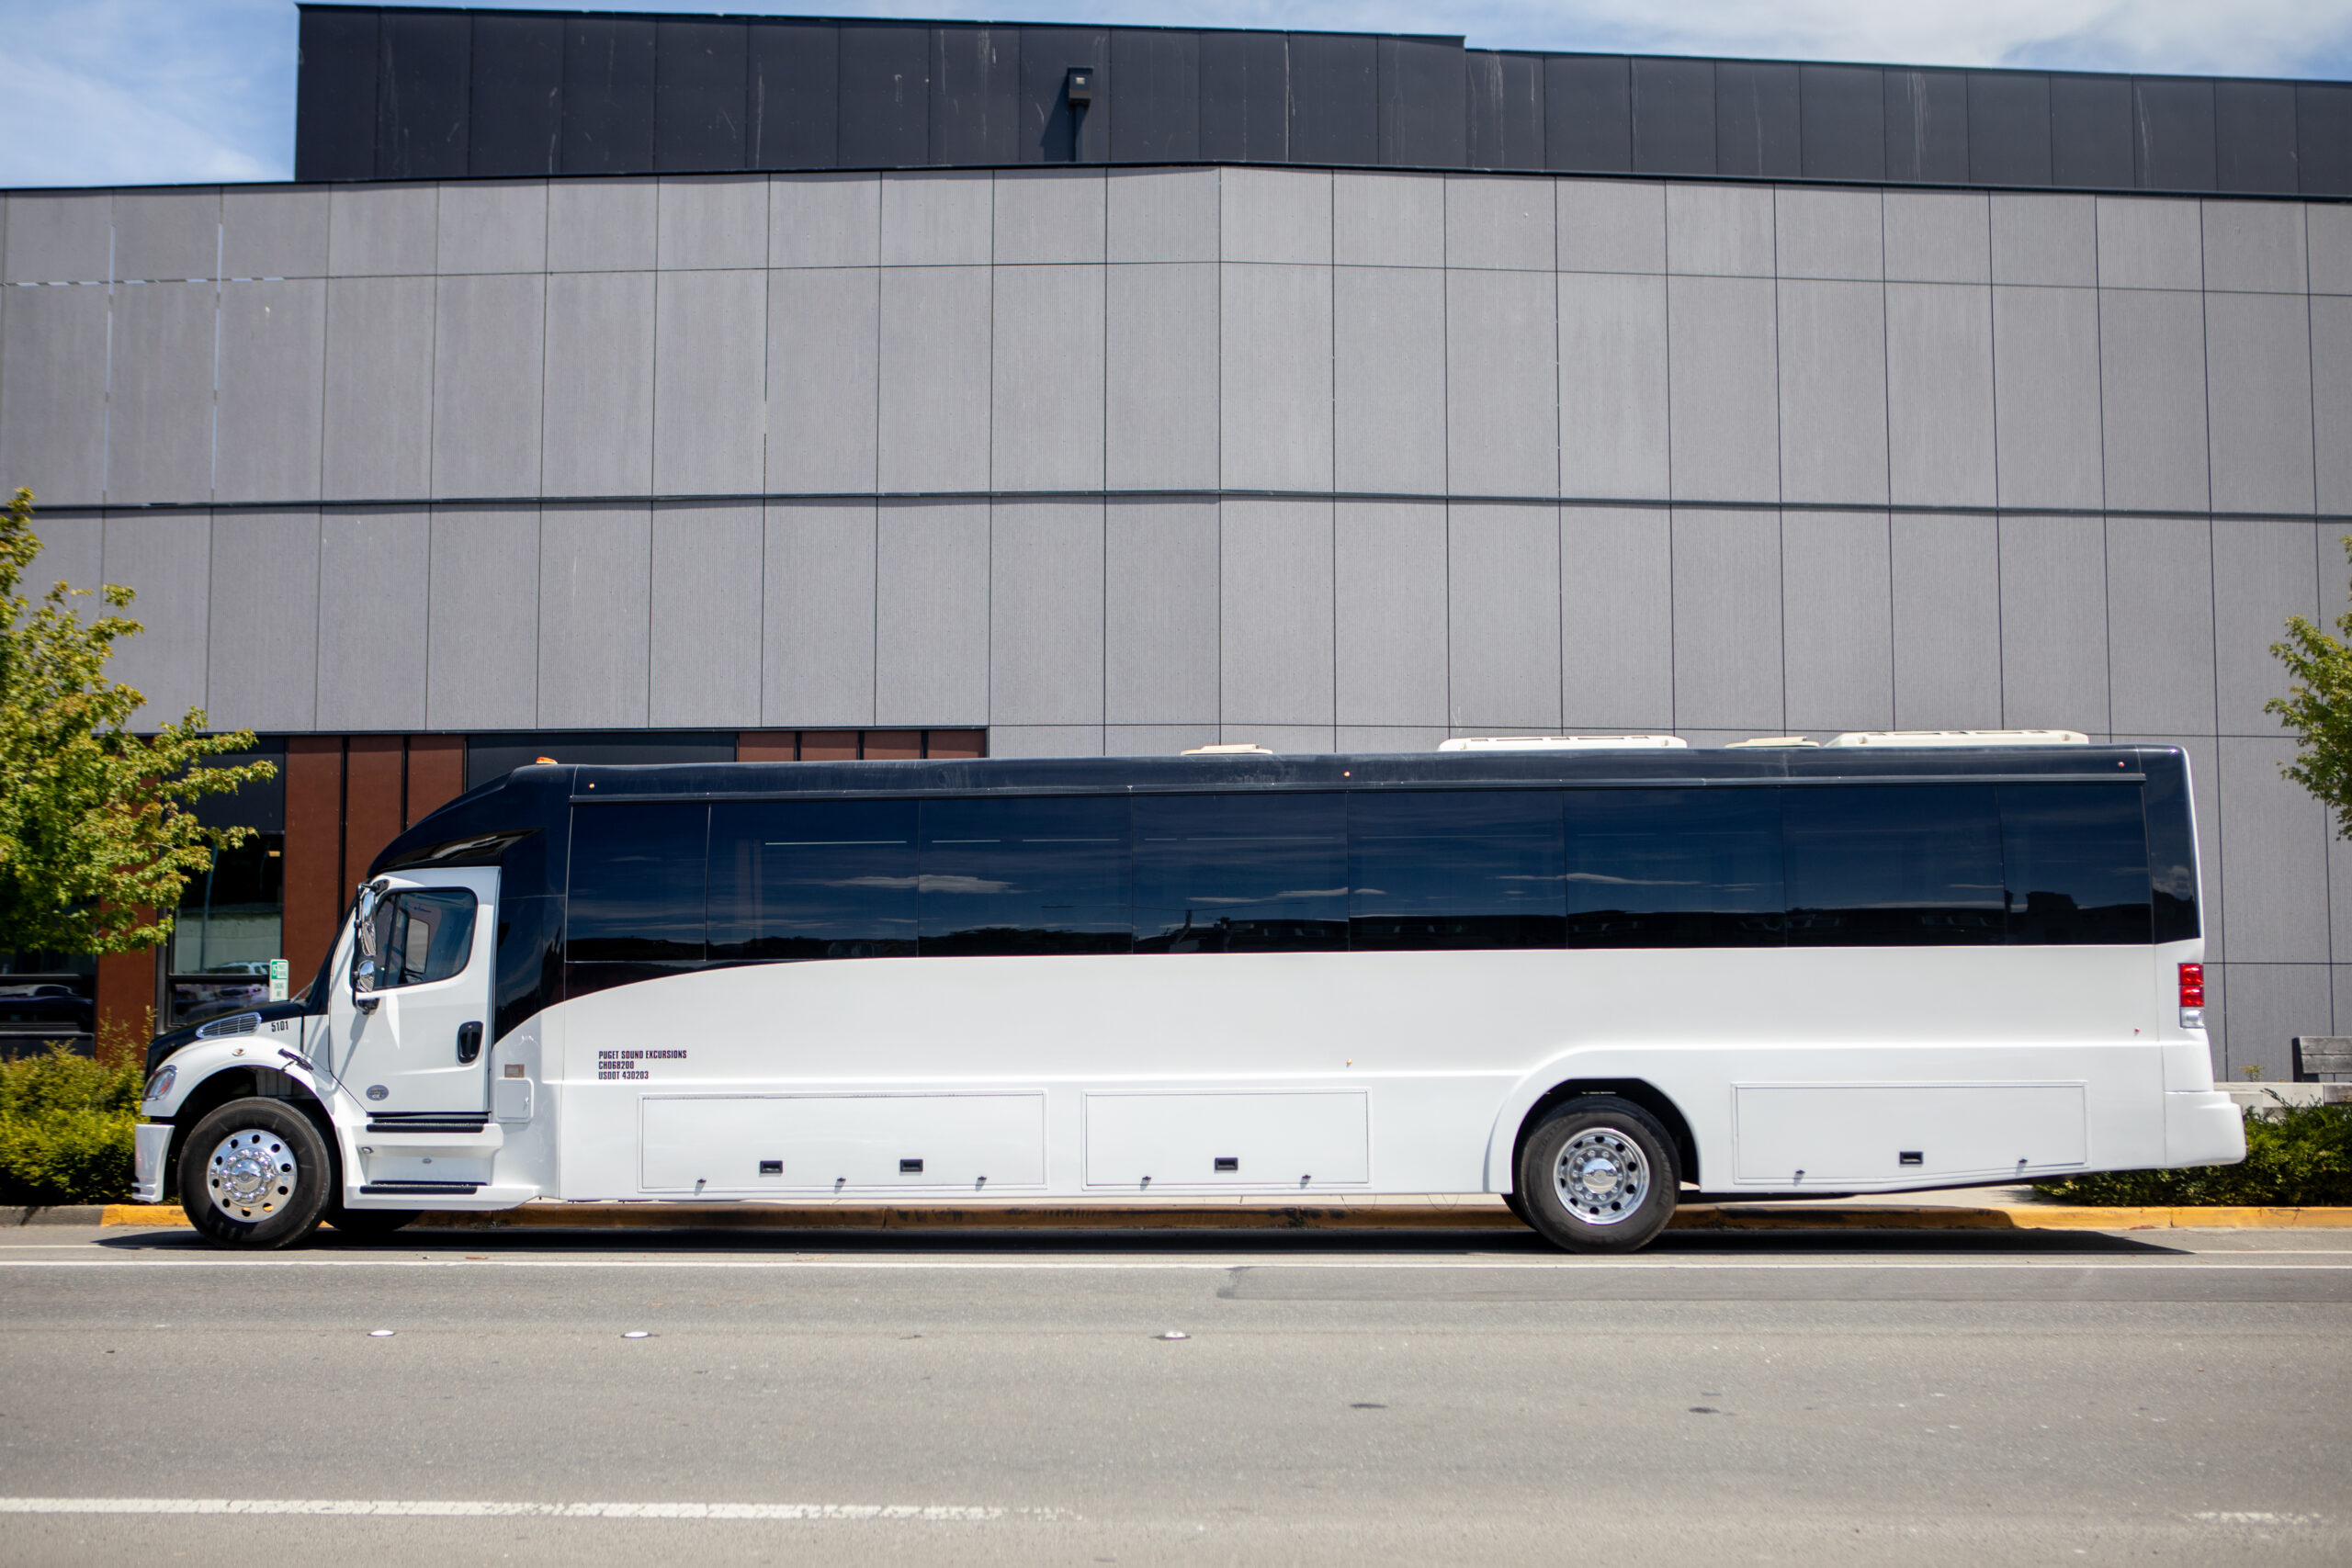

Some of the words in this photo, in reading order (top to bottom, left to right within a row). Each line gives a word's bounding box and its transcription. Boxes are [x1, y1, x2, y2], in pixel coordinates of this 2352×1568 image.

[271, 1021, 288, 1032] 5101
[598, 1050, 619, 1059] PUGET
[621, 1050, 643, 1059] SOUND
[646, 1050, 687, 1059] EXCURSIONS
[598, 1071, 619, 1080] USDOT
[622, 1070, 649, 1079] 430203
